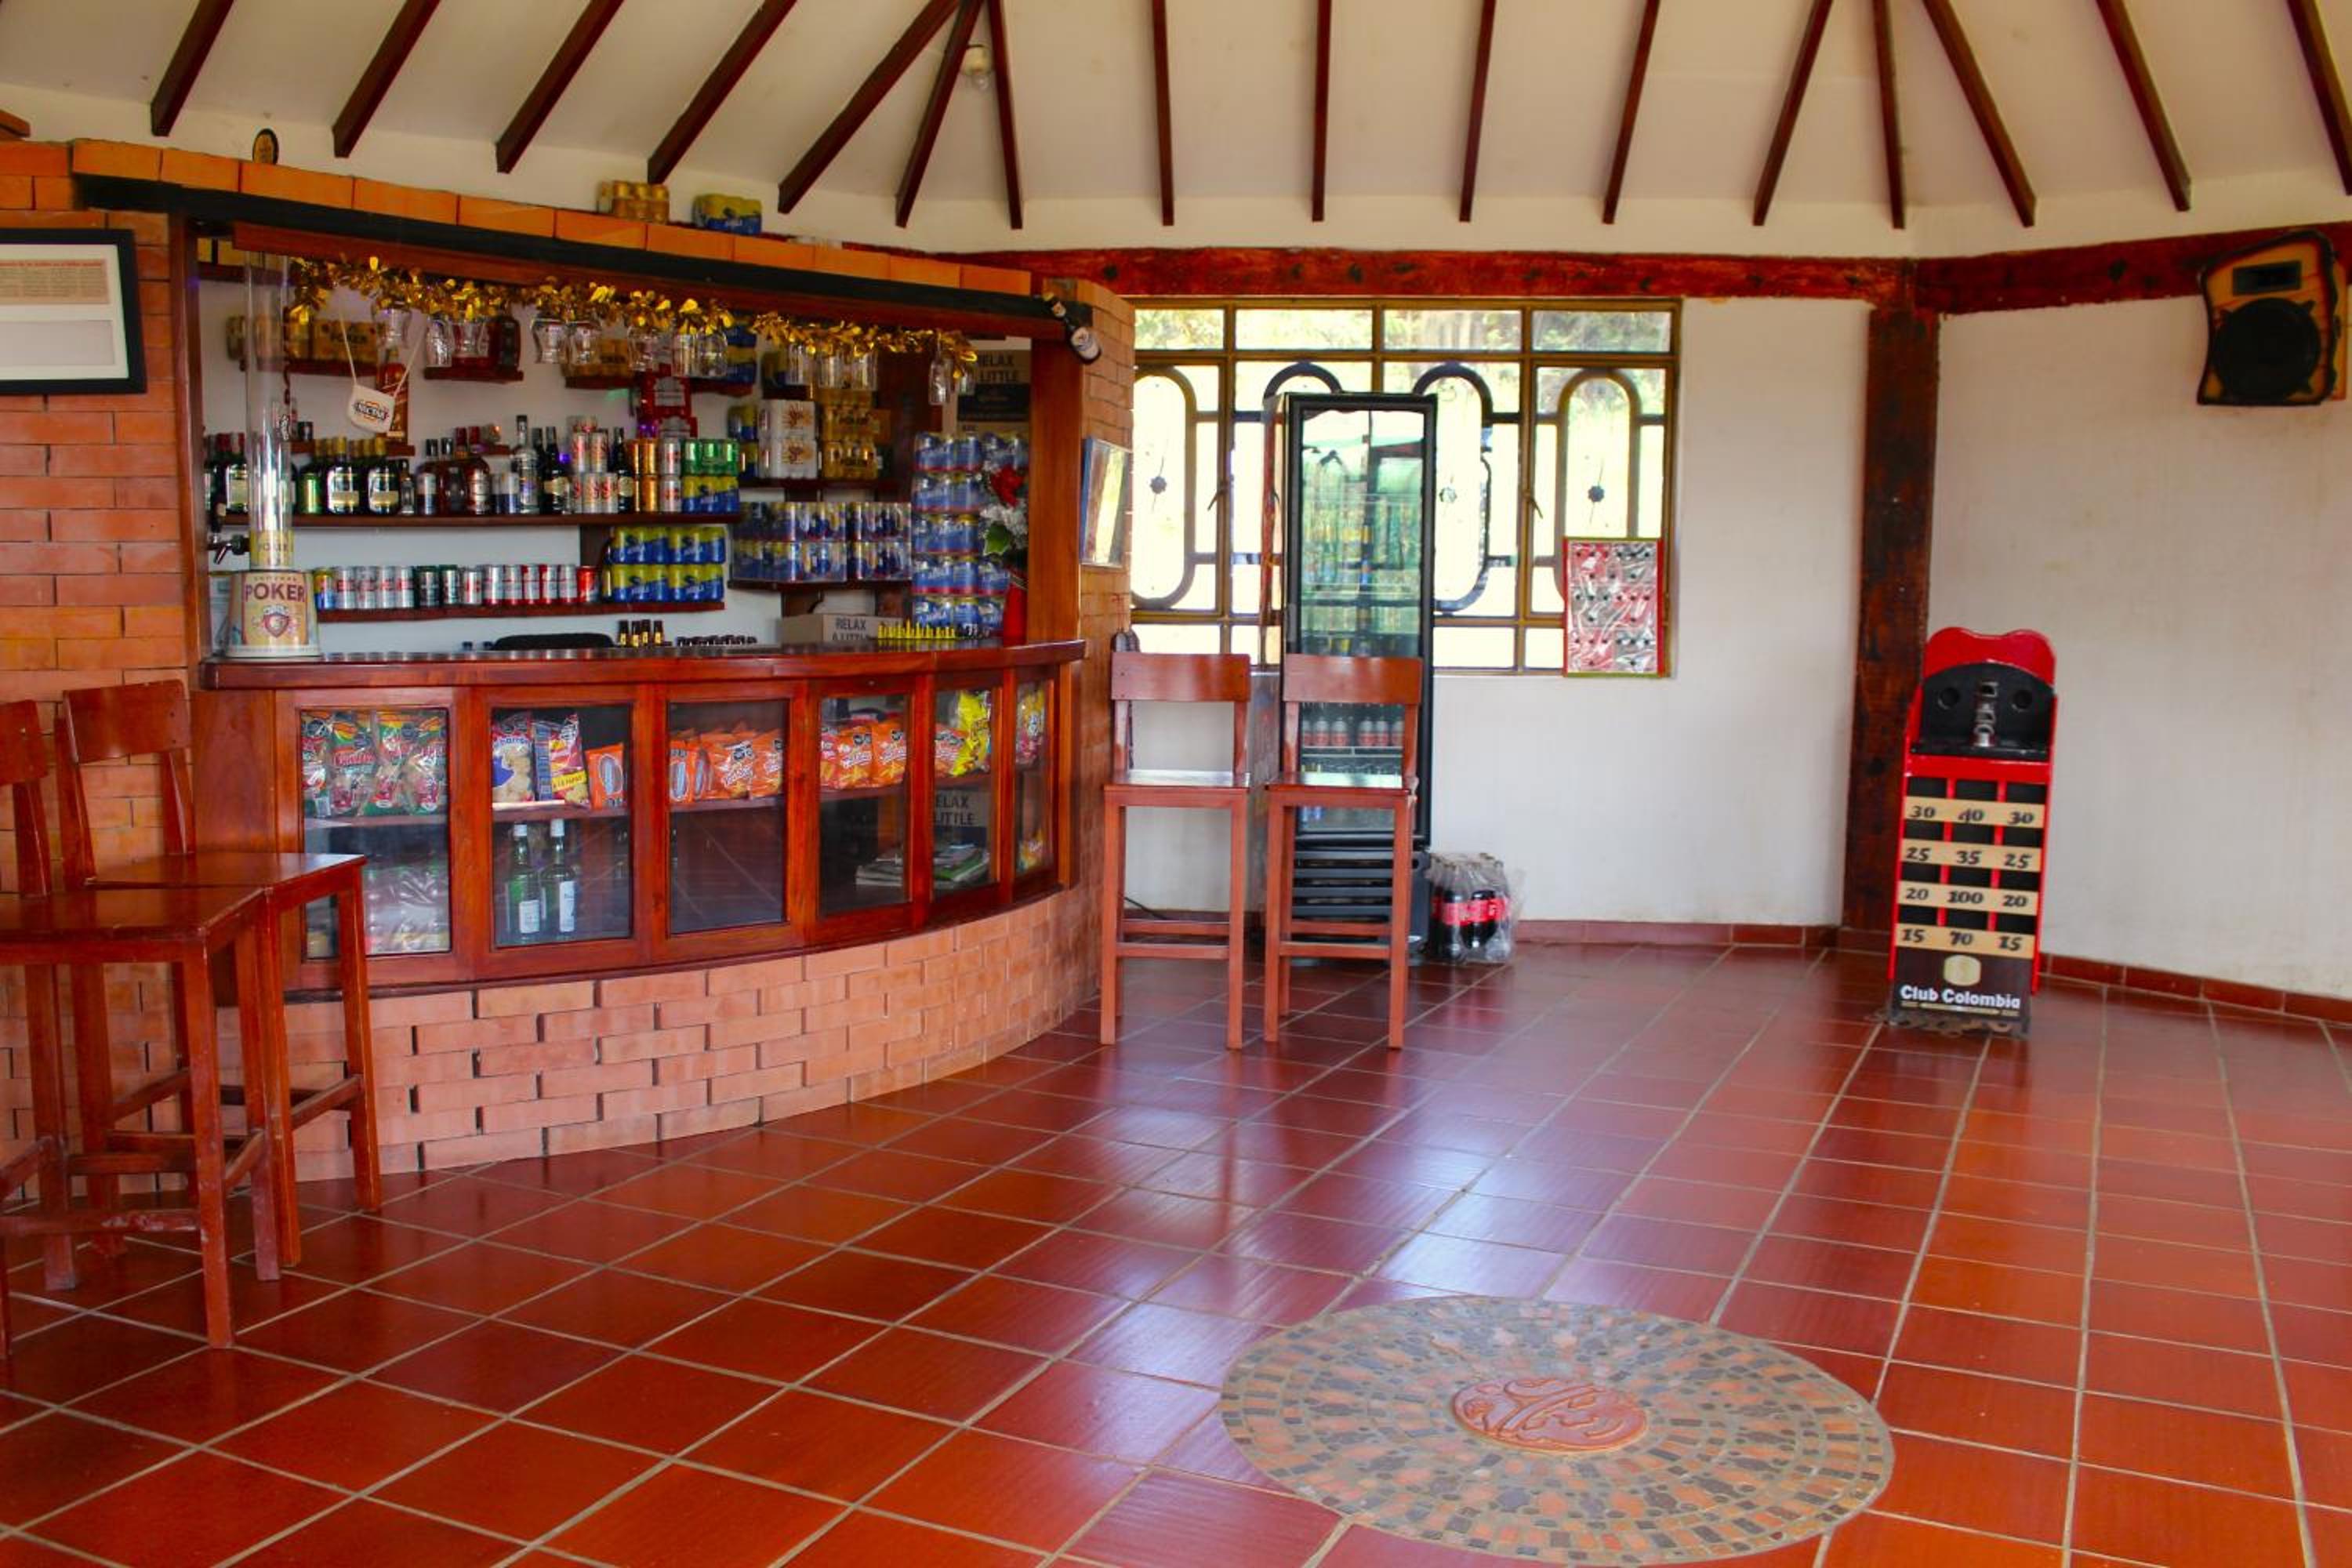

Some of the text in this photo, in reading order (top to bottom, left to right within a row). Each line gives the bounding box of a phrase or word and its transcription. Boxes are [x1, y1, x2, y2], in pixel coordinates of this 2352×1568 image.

[245, 583, 307, 602] POKER
[836, 617, 866, 630] RELAX
[1910, 805, 2034, 825] 30 40 30
[1907, 847, 2032, 869] 25 35 25
[1906, 888, 2028, 907] 20 100 20
[1902, 928, 2023, 951] 15 70 15
[1900, 985, 2020, 1009] Club Colombia
